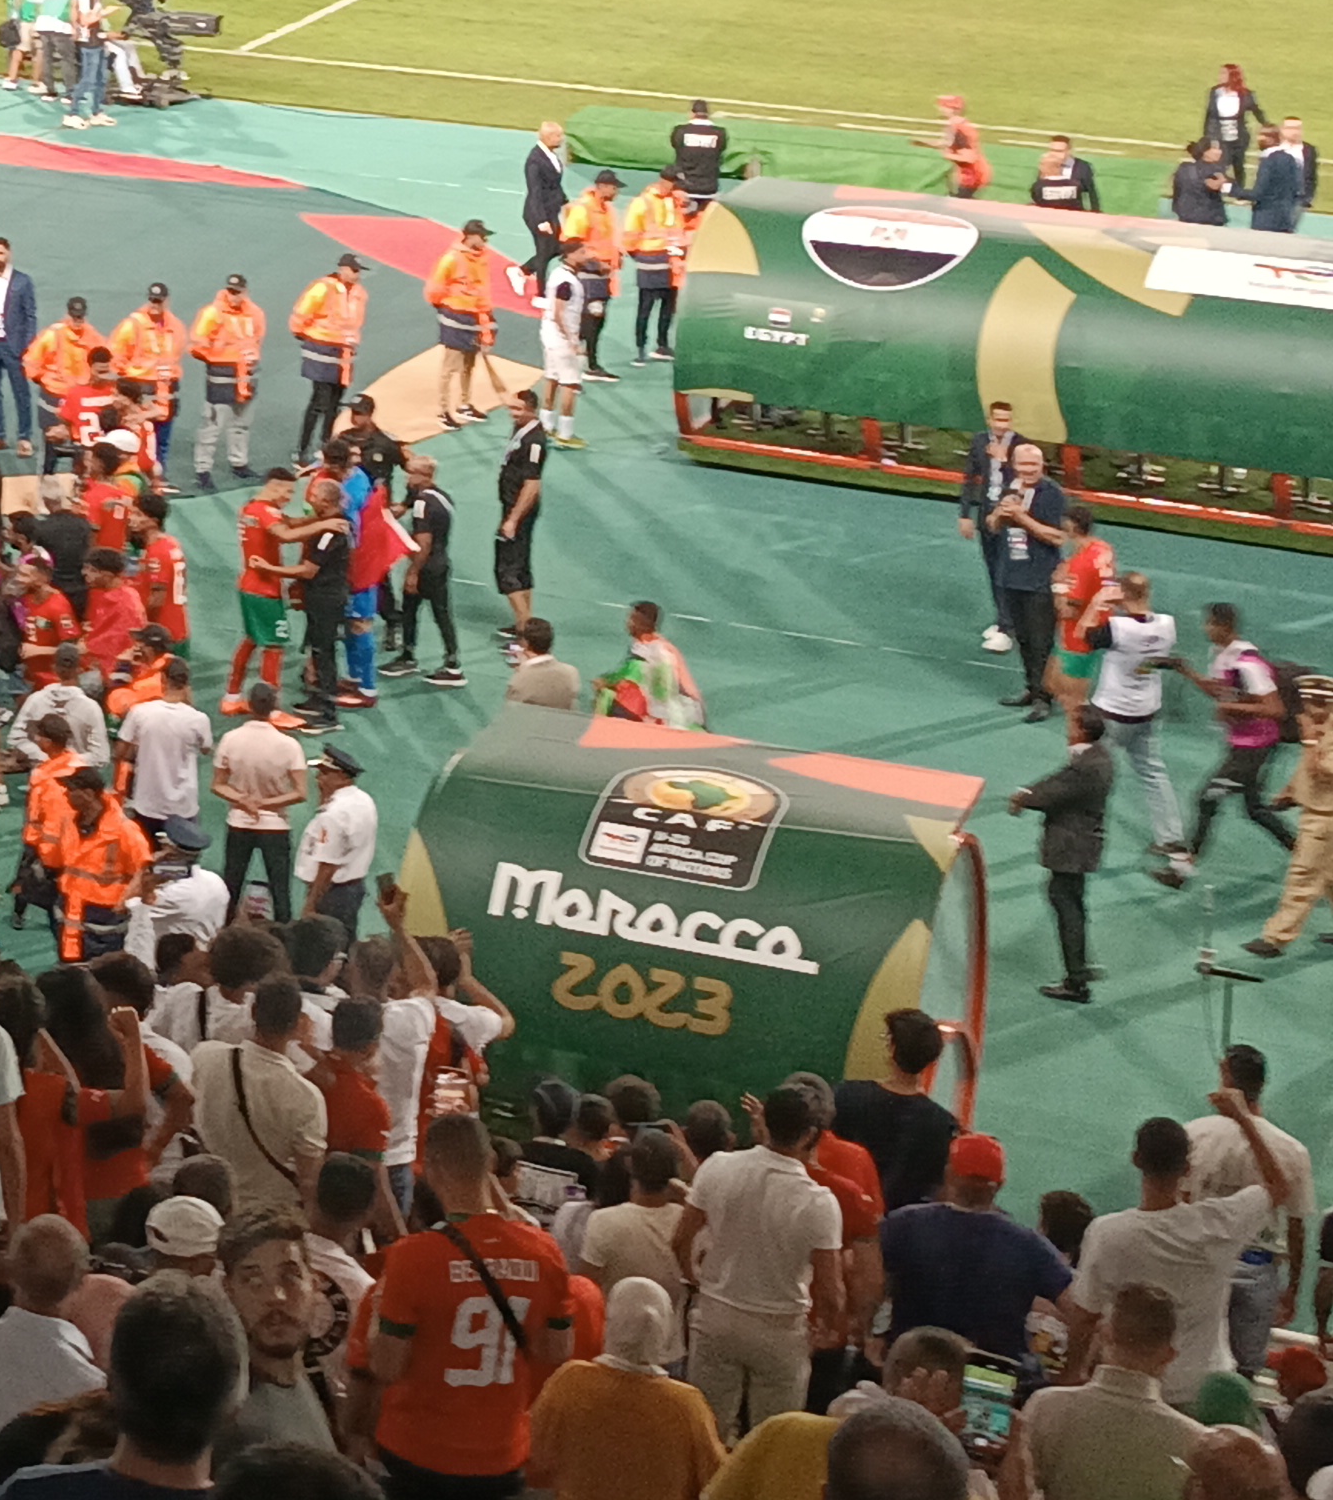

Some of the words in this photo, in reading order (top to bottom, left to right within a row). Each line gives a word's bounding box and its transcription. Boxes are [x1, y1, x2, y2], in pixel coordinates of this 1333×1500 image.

[743, 325, 810, 347] EGYPT
[632, 806, 735, 832] CAF
[551, 951, 734, 1036] 2023
